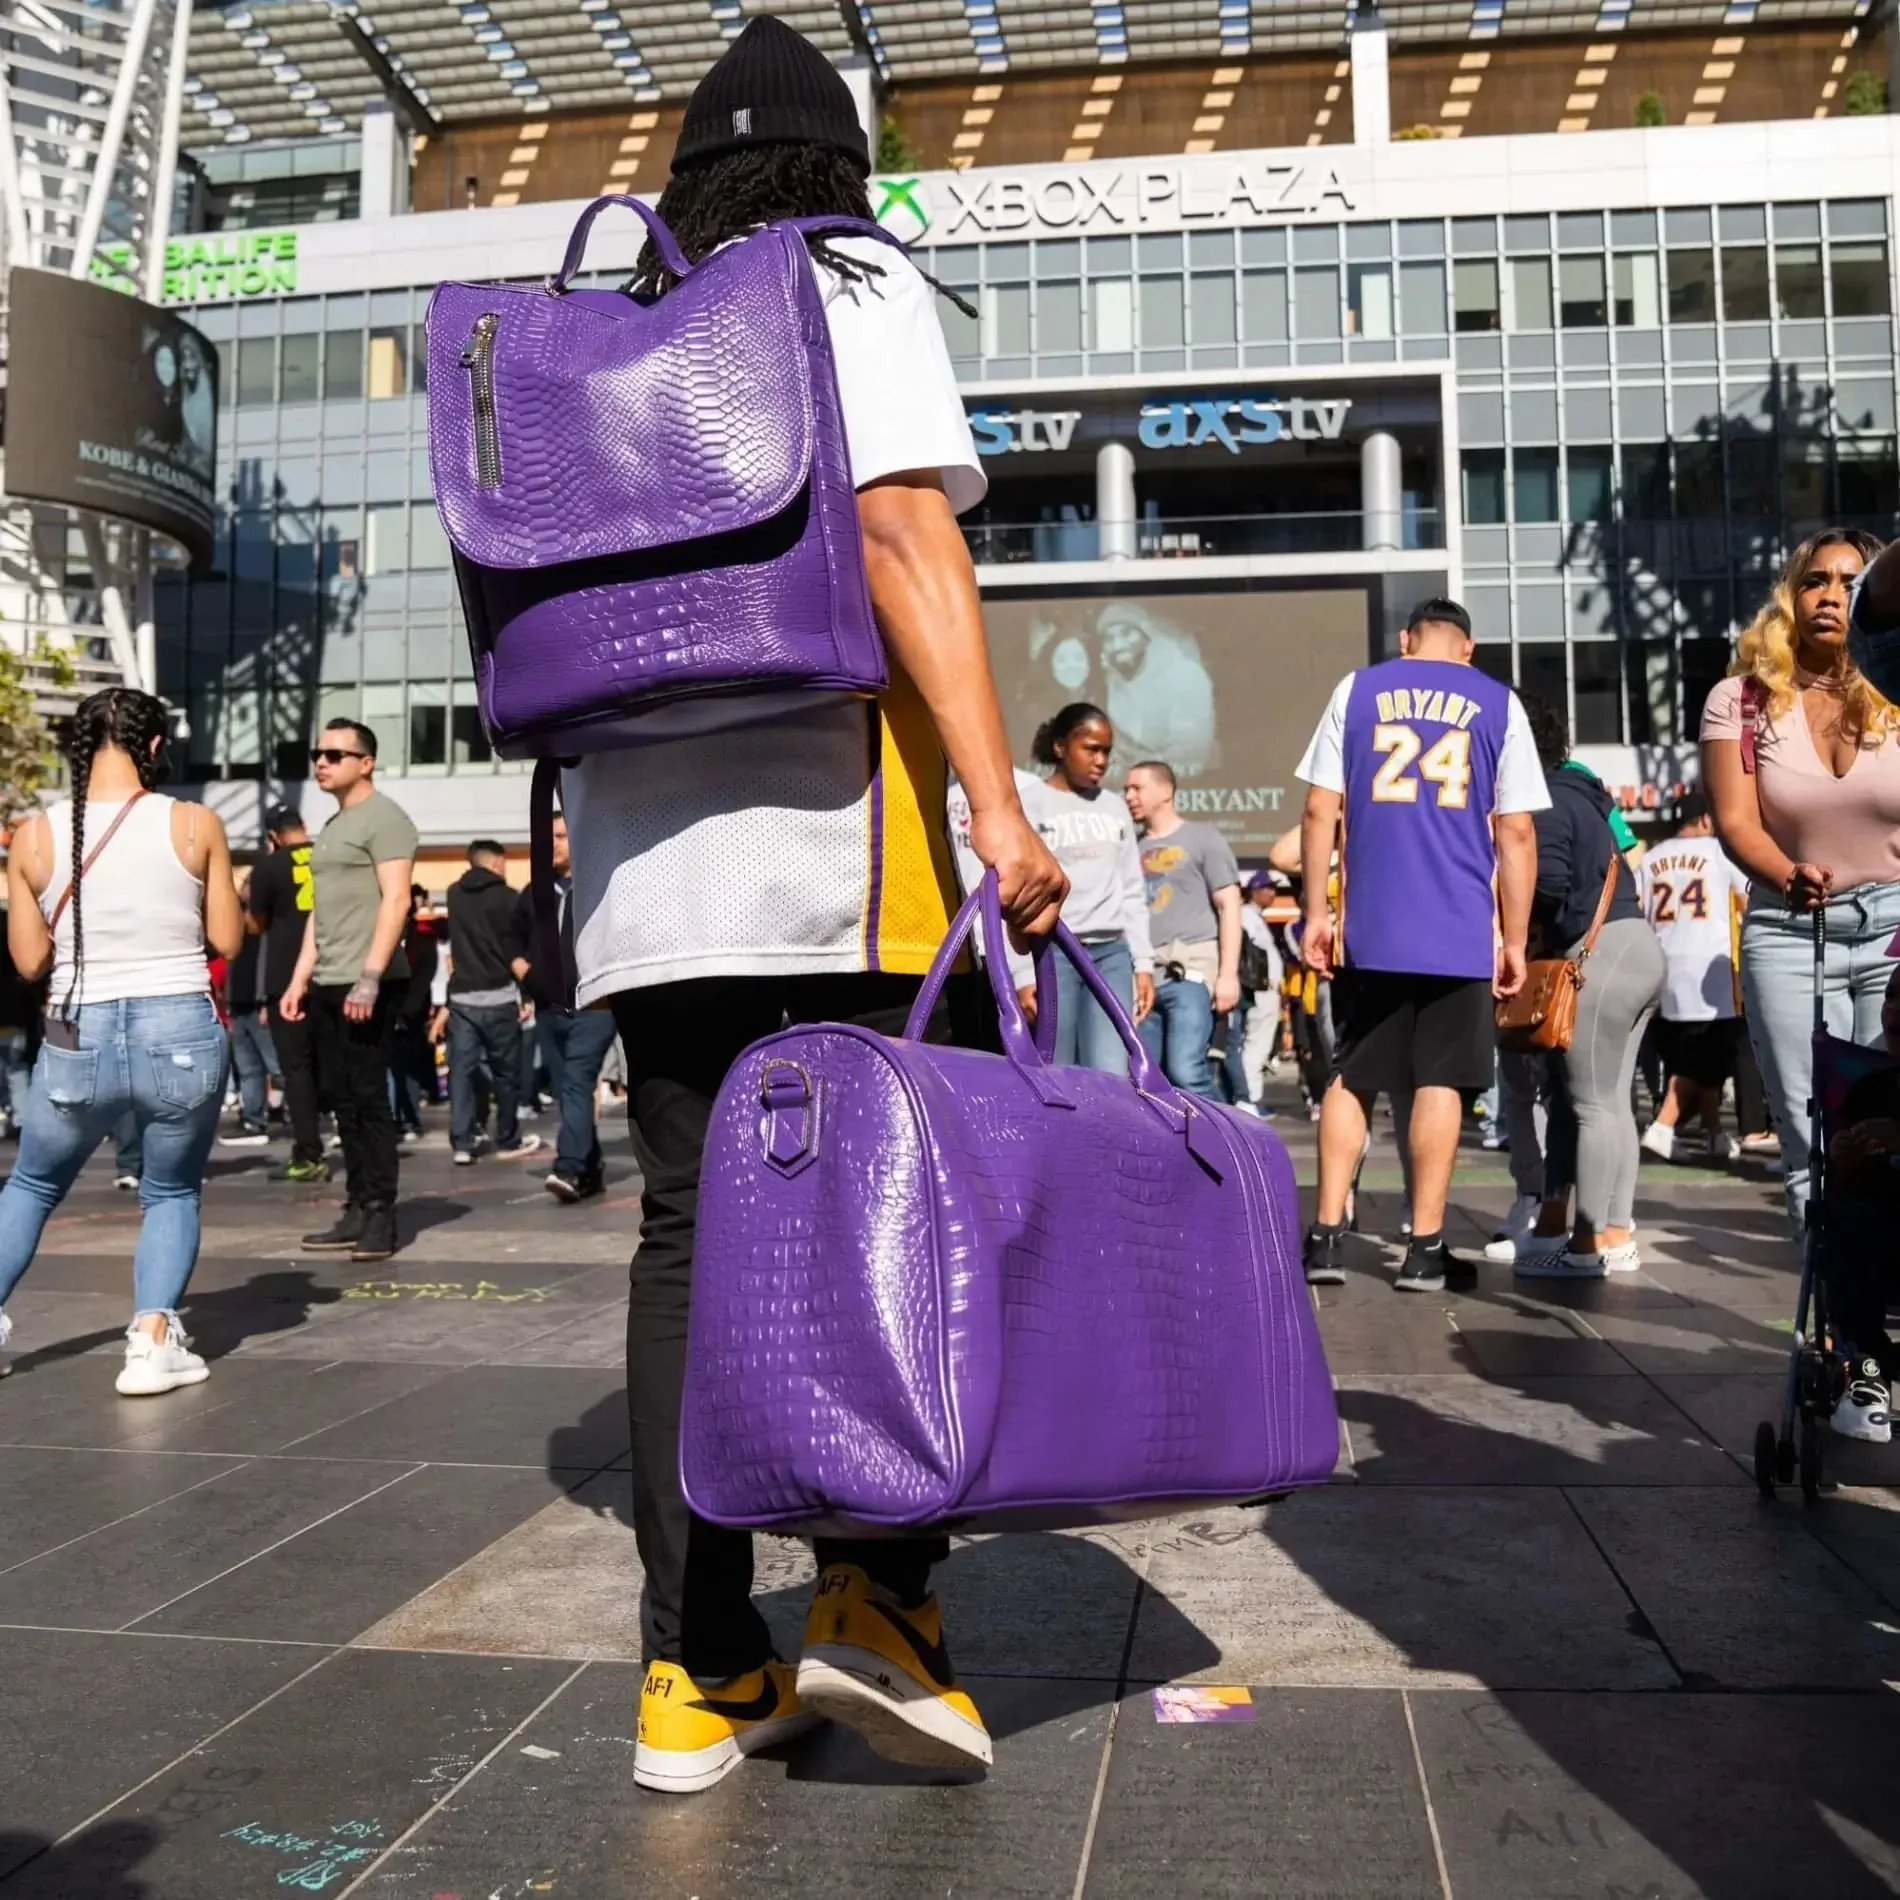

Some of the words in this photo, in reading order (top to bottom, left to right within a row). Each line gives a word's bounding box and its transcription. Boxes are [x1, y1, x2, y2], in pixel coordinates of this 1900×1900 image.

[946, 171, 1124, 236] XBOX
[1137, 162, 1356, 223] PLAZA
[89, 231, 297, 277] EBALIFE
[79, 440, 134, 472] KOBE
[1376, 688, 1482, 729] BRYANT
[1372, 724, 1472, 809] 24
[1175, 787, 1285, 813] BRYANT
[1650, 853, 1708, 877] BRYANT
[1652, 878, 1707, 922] 24
[644, 1675, 674, 1699] AF-1
